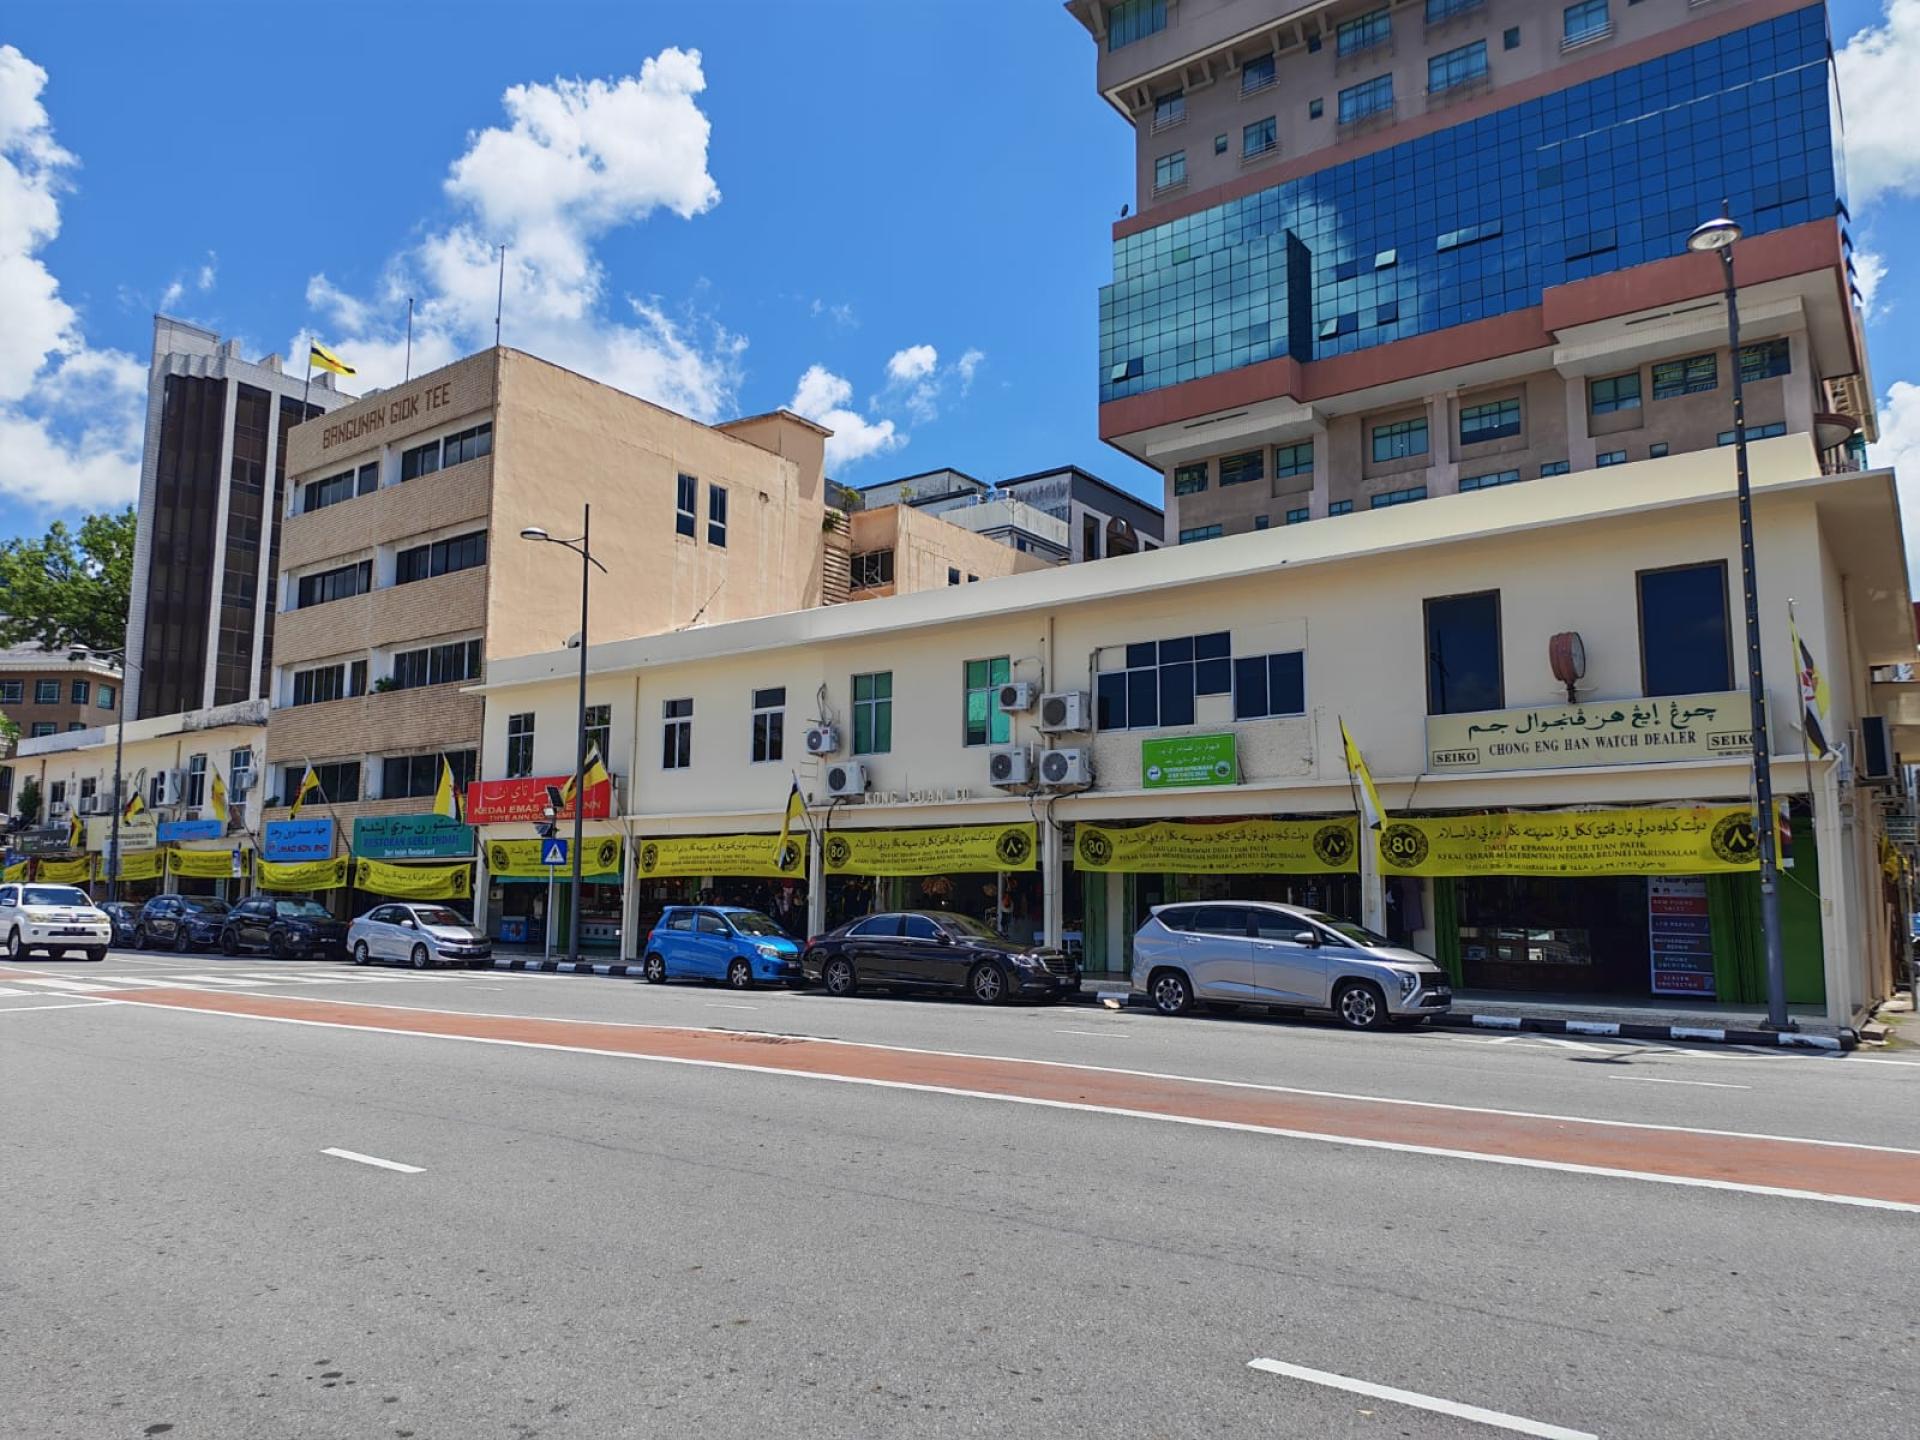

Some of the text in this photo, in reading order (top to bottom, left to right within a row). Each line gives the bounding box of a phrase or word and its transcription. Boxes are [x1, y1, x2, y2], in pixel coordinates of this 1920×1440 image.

[323, 382, 451, 449] BANGUNAN GIOK TEE
[1489, 731, 1697, 756] CHONG ENG HAN WATCH DEALER
[1436, 752, 1476, 763] SEIKO
[474, 806, 506, 815] KEDAI
[508, 804, 540, 813] EMAS
[543, 802, 574, 811] TE
[831, 846, 844, 857] 80
[1088, 839, 1105, 855] 80
[1392, 838, 1417, 854] 80
[1559, 851, 1595, 859] NEGARA
[1634, 849, 1698, 857] DARUSSALAM
